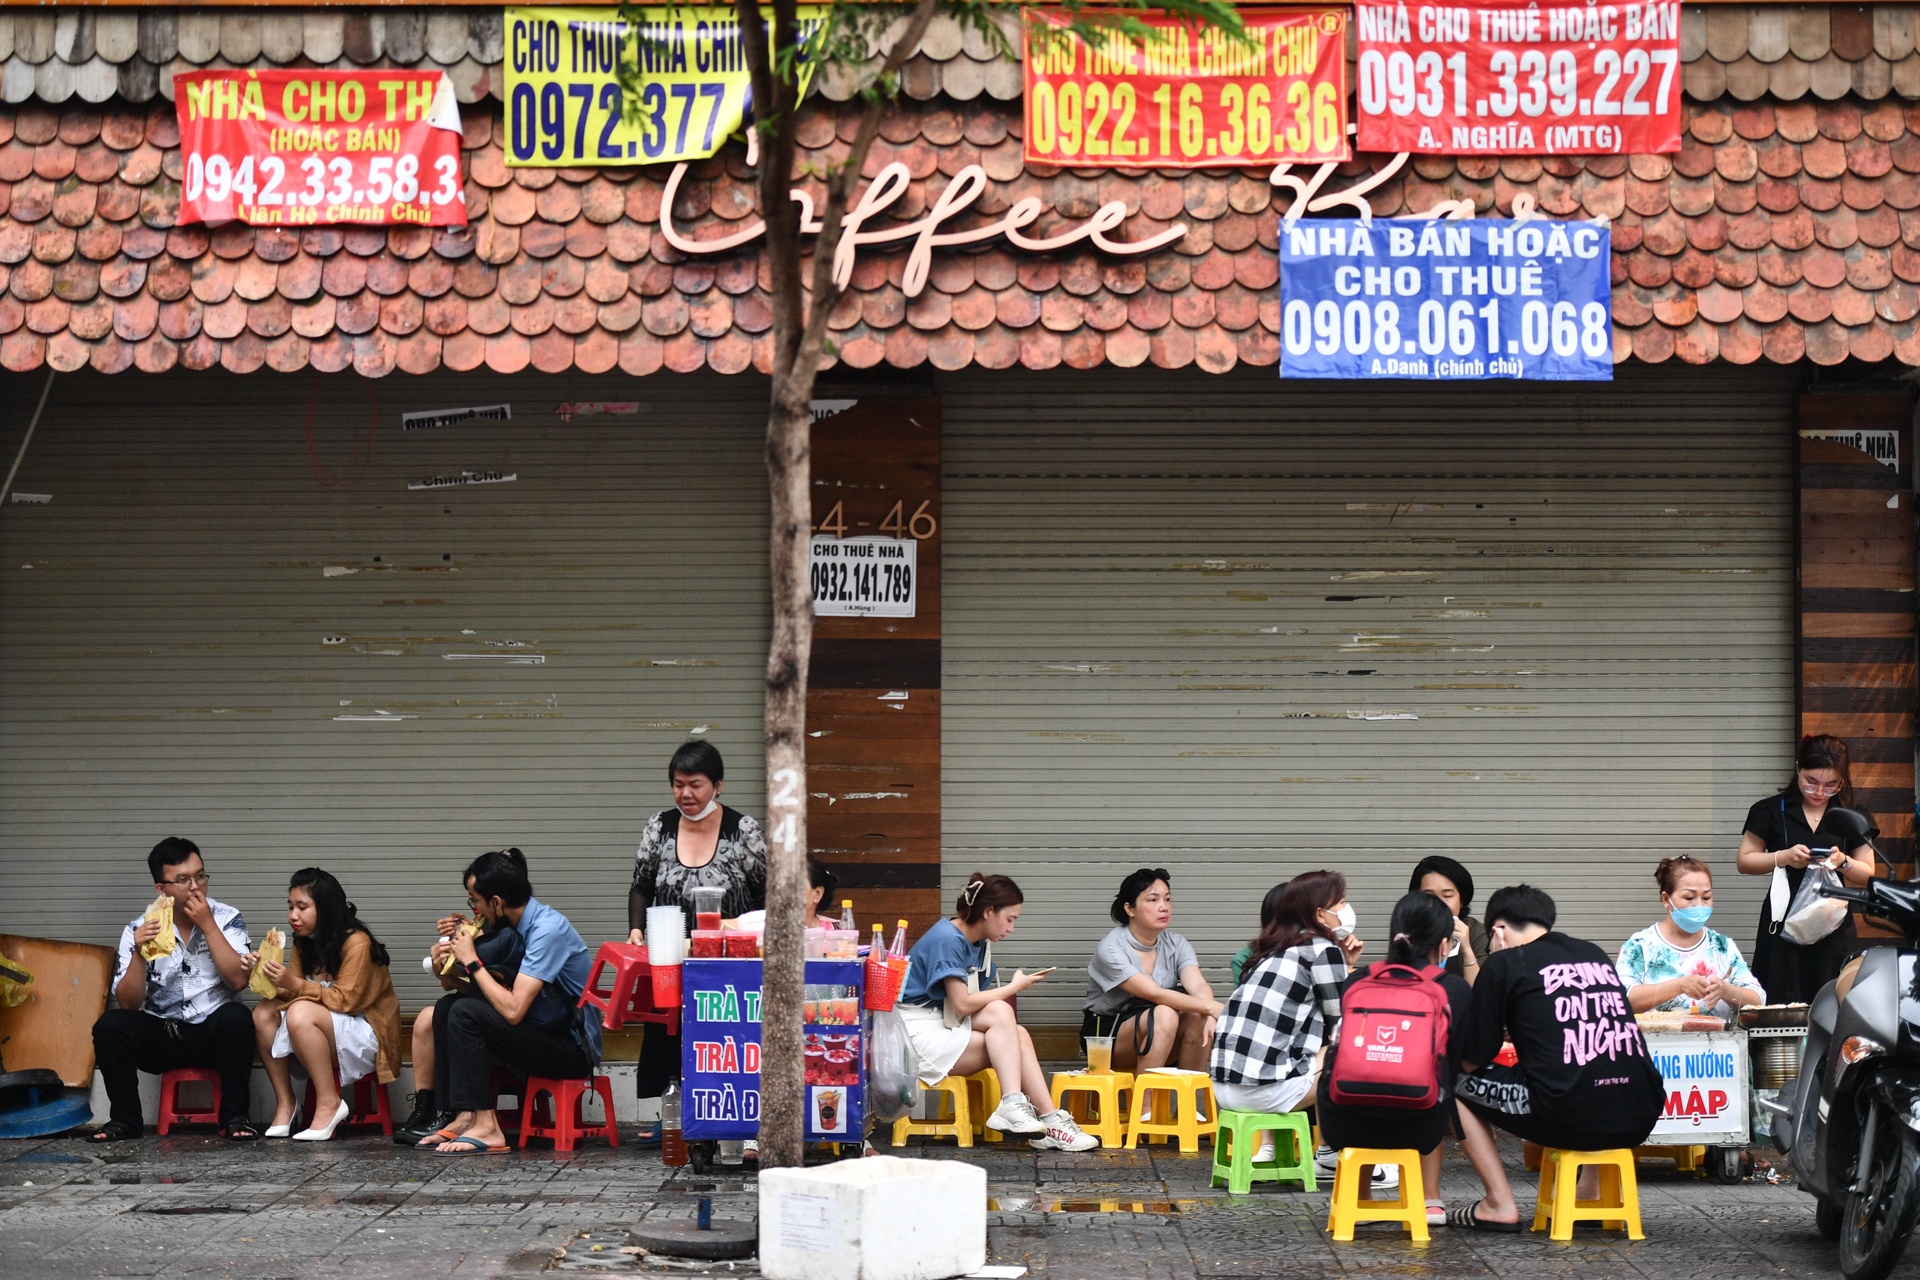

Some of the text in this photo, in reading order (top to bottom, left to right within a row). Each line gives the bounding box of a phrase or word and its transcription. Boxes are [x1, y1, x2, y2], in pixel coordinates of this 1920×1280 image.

[512, 20, 560, 74] CHO
[568, 8, 627, 74] THUÊ
[636, 8, 688, 74] NHÀ
[1358, 0, 1677, 50] NHÀ CHO THUÊ HOẶC BÁN
[1273, 14, 1318, 77] CHỦ
[186, 69, 440, 123] NHÀ CHO TH
[1359, 48, 1679, 118] 0931.339.227
[1031, 79, 1339, 158] 0922.16.36.36
[1417, 121, 1622, 154] A. NGHĨA (MTG)
[269, 123, 402, 158] (HOẶC BÁN)
[185, 152, 466, 207] 0942.33.58.3
[237, 202, 432, 226] Liên Hệ Chính Chủ
[1289, 220, 1600, 265] NHÀ BÁN HOẶC
[1334, 261, 1543, 297] CHO THUÊ
[1283, 298, 1608, 357] 0908.061.068
[1370, 358, 1524, 378] A.Danh (chính chủ)
[1865, 432, 1897, 459] NHÀ
[878, 499, 937, 540] 46
[813, 543, 905, 558] CHO THUÊ NHÀ
[810, 561, 912, 603] 0932.141.789
[1538, 962, 1621, 996] BRING
[694, 984, 740, 1022] TRÀ
[1554, 991, 1627, 1023] ON THE
[693, 1035, 761, 1074] TRÀ D
[1562, 1016, 1645, 1067] NIGHT
[1685, 1048, 1734, 1079] NƯỚNG
[692, 1083, 761, 1122] TRÀ Đ
[1659, 1085, 1730, 1126] MẬP
[1046, 1126, 1076, 1145] OSTON
